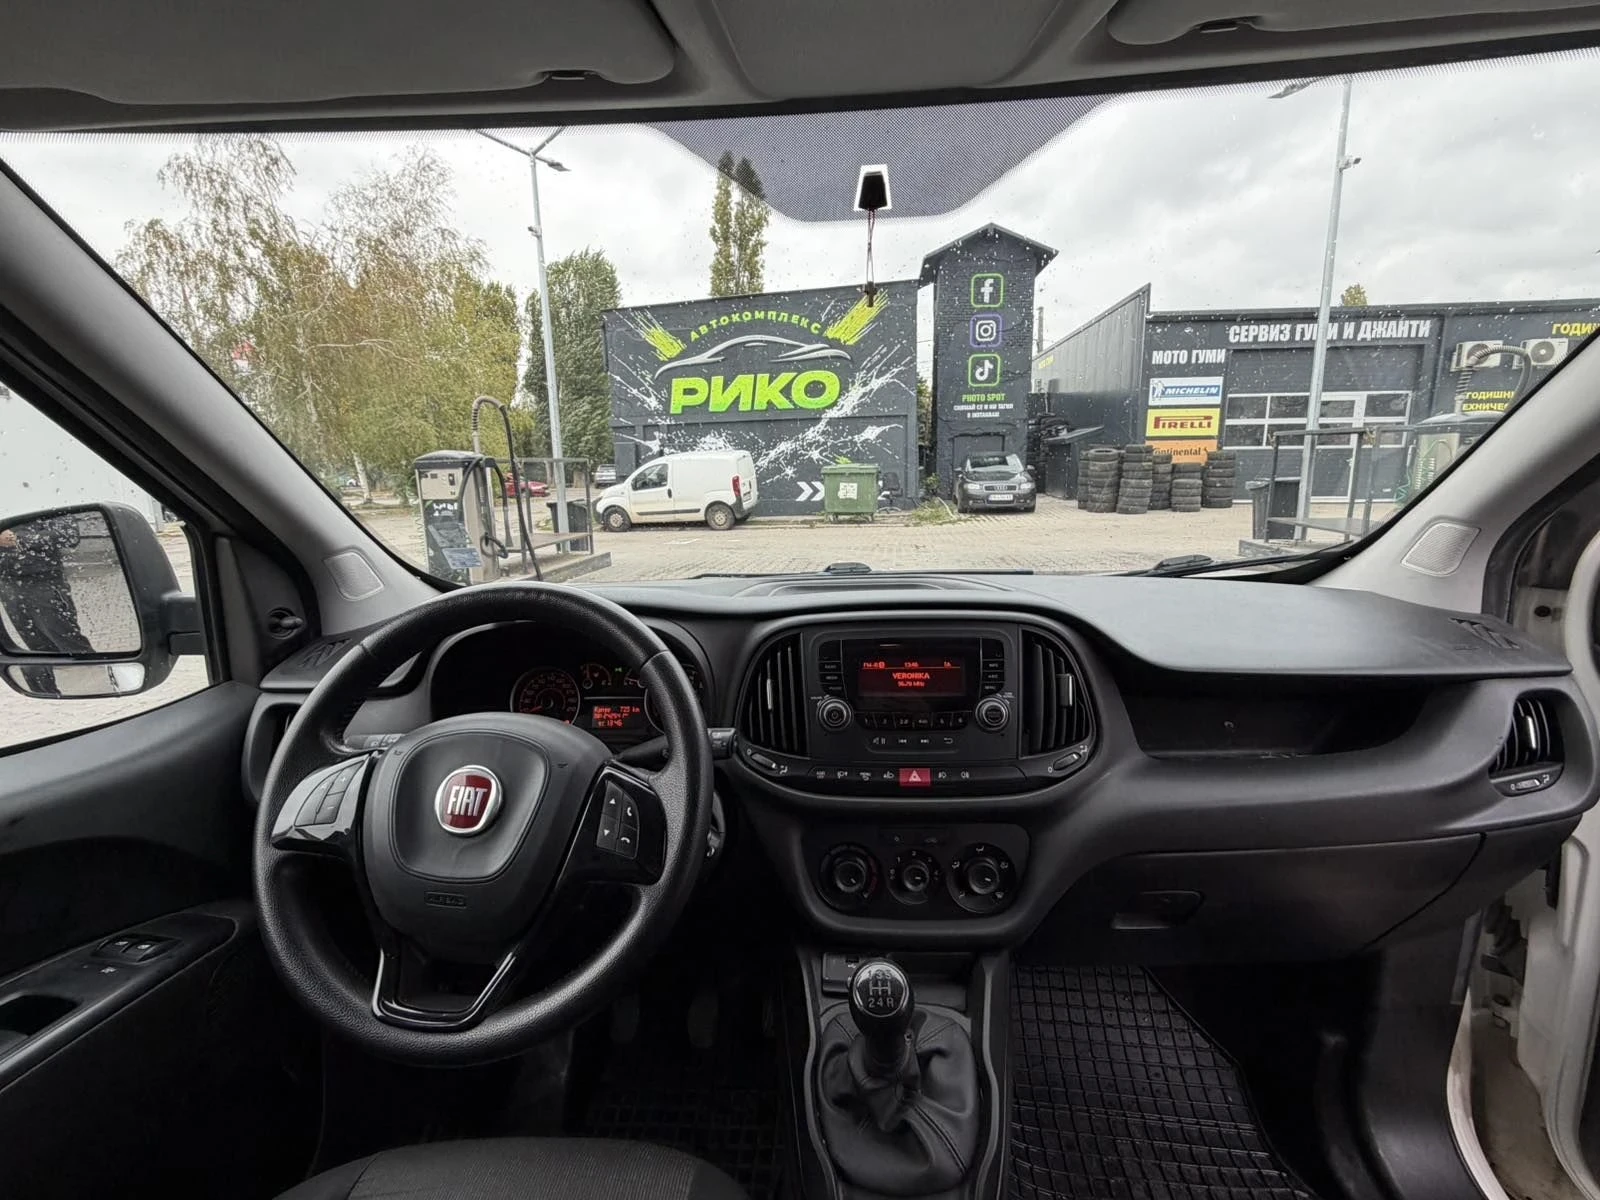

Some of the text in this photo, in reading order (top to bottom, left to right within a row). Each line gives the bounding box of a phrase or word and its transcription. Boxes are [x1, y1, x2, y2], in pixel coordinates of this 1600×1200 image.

[690, 310, 821, 341] АВТОКОМПЛЕКС
[1228, 323, 1292, 343] СЕРВИЗ
[1342, 321, 1355, 340] И
[1356, 319, 1431, 341] ДЖАНТИ
[1151, 349, 1226, 364] МОТО ГУМИ
[669, 370, 841, 414] РИКО
[962, 393, 1005, 402] PHOTO SPOT
[1165, 386, 1219, 395] MICHELIN
[1154, 415, 1213, 429] PIRELLI
[892, 672, 930, 680] VERONIKA
[447, 785, 488, 816] FIAT
[868, 997, 876, 1008] 2
